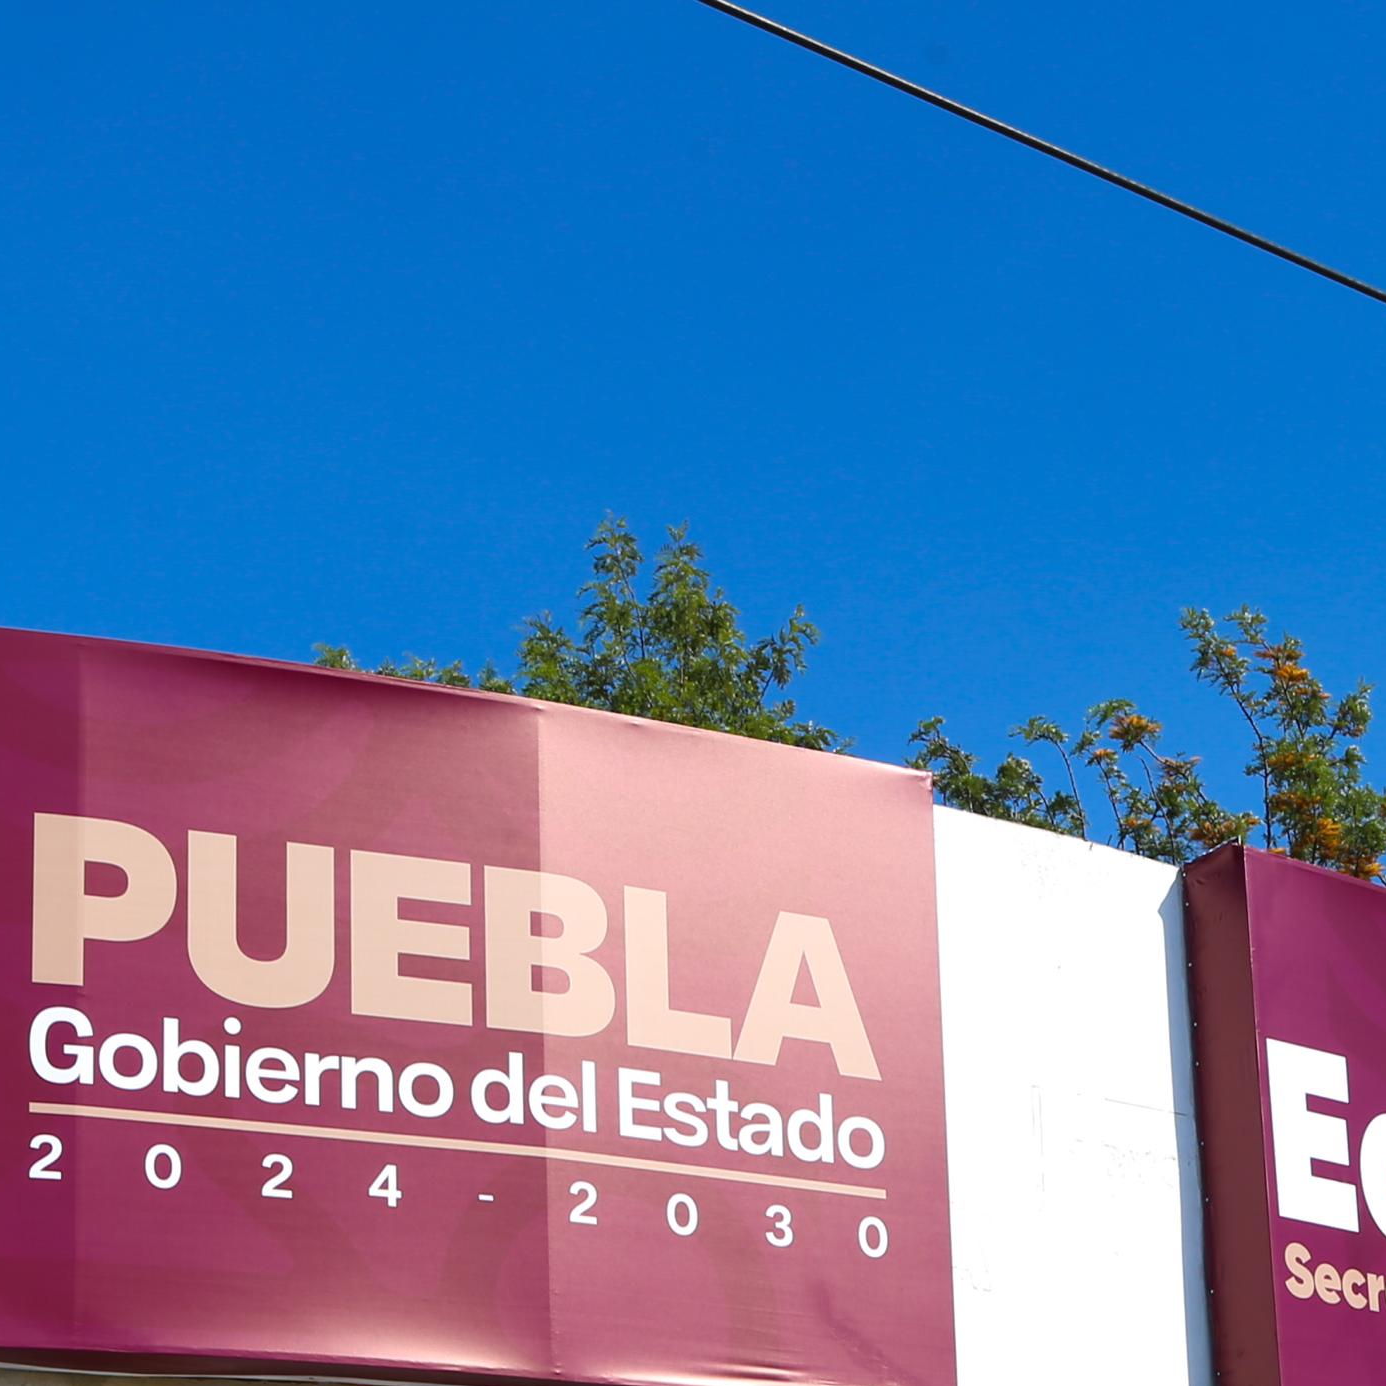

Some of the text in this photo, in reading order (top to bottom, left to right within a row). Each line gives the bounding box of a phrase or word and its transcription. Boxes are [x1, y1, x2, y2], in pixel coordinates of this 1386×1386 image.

[31, 811, 883, 1081] PUEBLA
[28, 1005, 886, 1169] Gobierno del Estado
